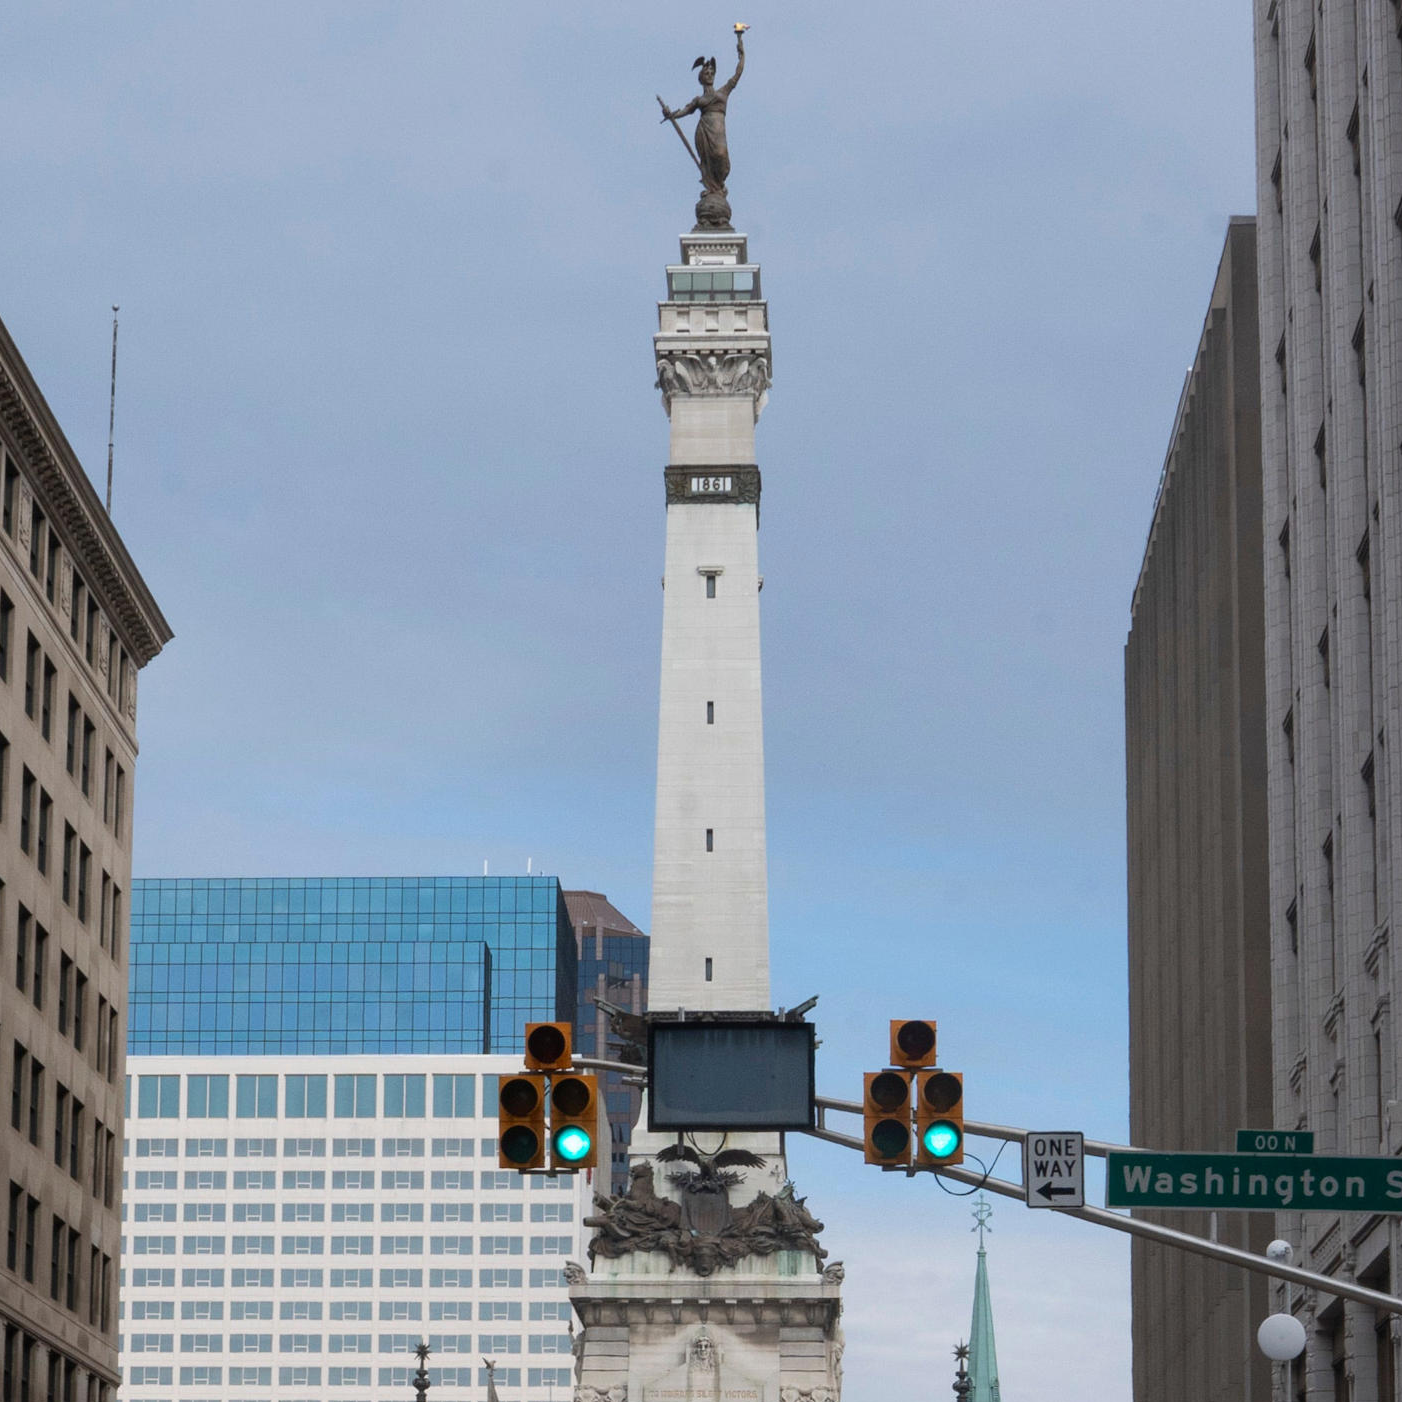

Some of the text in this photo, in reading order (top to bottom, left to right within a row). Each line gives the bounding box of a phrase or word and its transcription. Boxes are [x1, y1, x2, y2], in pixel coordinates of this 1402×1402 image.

[697, 477, 726, 492] 1861
[1034, 1138, 1075, 1157] ONE
[1284, 1135, 1296, 1151] N
[1034, 1160, 1076, 1178] WAY
[1123, 1165, 1365, 1205] Washington
